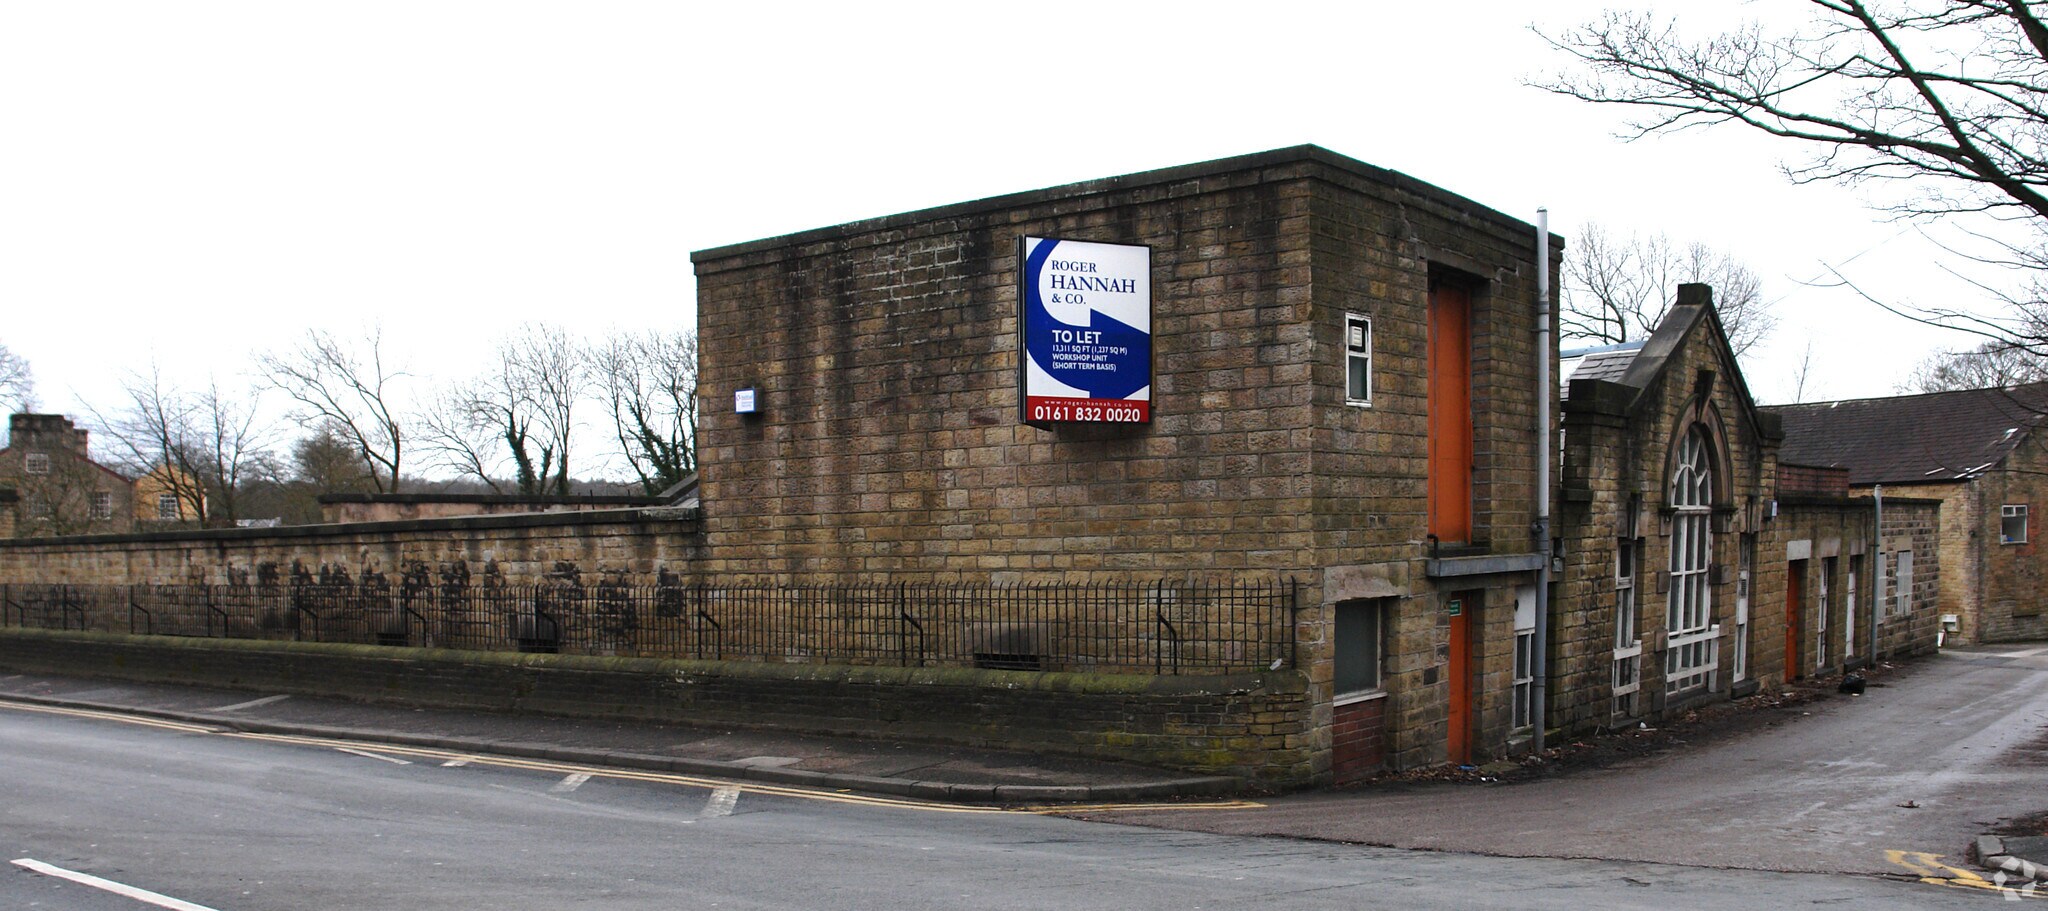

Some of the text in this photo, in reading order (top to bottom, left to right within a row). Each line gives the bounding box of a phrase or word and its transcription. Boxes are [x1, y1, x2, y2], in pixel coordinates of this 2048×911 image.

[1051, 260, 1096, 272] ROGER
[1051, 274, 1136, 293] HANNAH
[1052, 293, 1086, 304] & CO.
[1052, 330, 1102, 344] TO LET
[1072, 345, 1080, 353] SQ
[1110, 346, 1118, 354] SQ
[1052, 353, 1090, 361] WORKSHOP
[1052, 361, 1116, 372] (SHORT TERM BASIS)
[1034, 406, 1140, 422] 0161 832 0020
